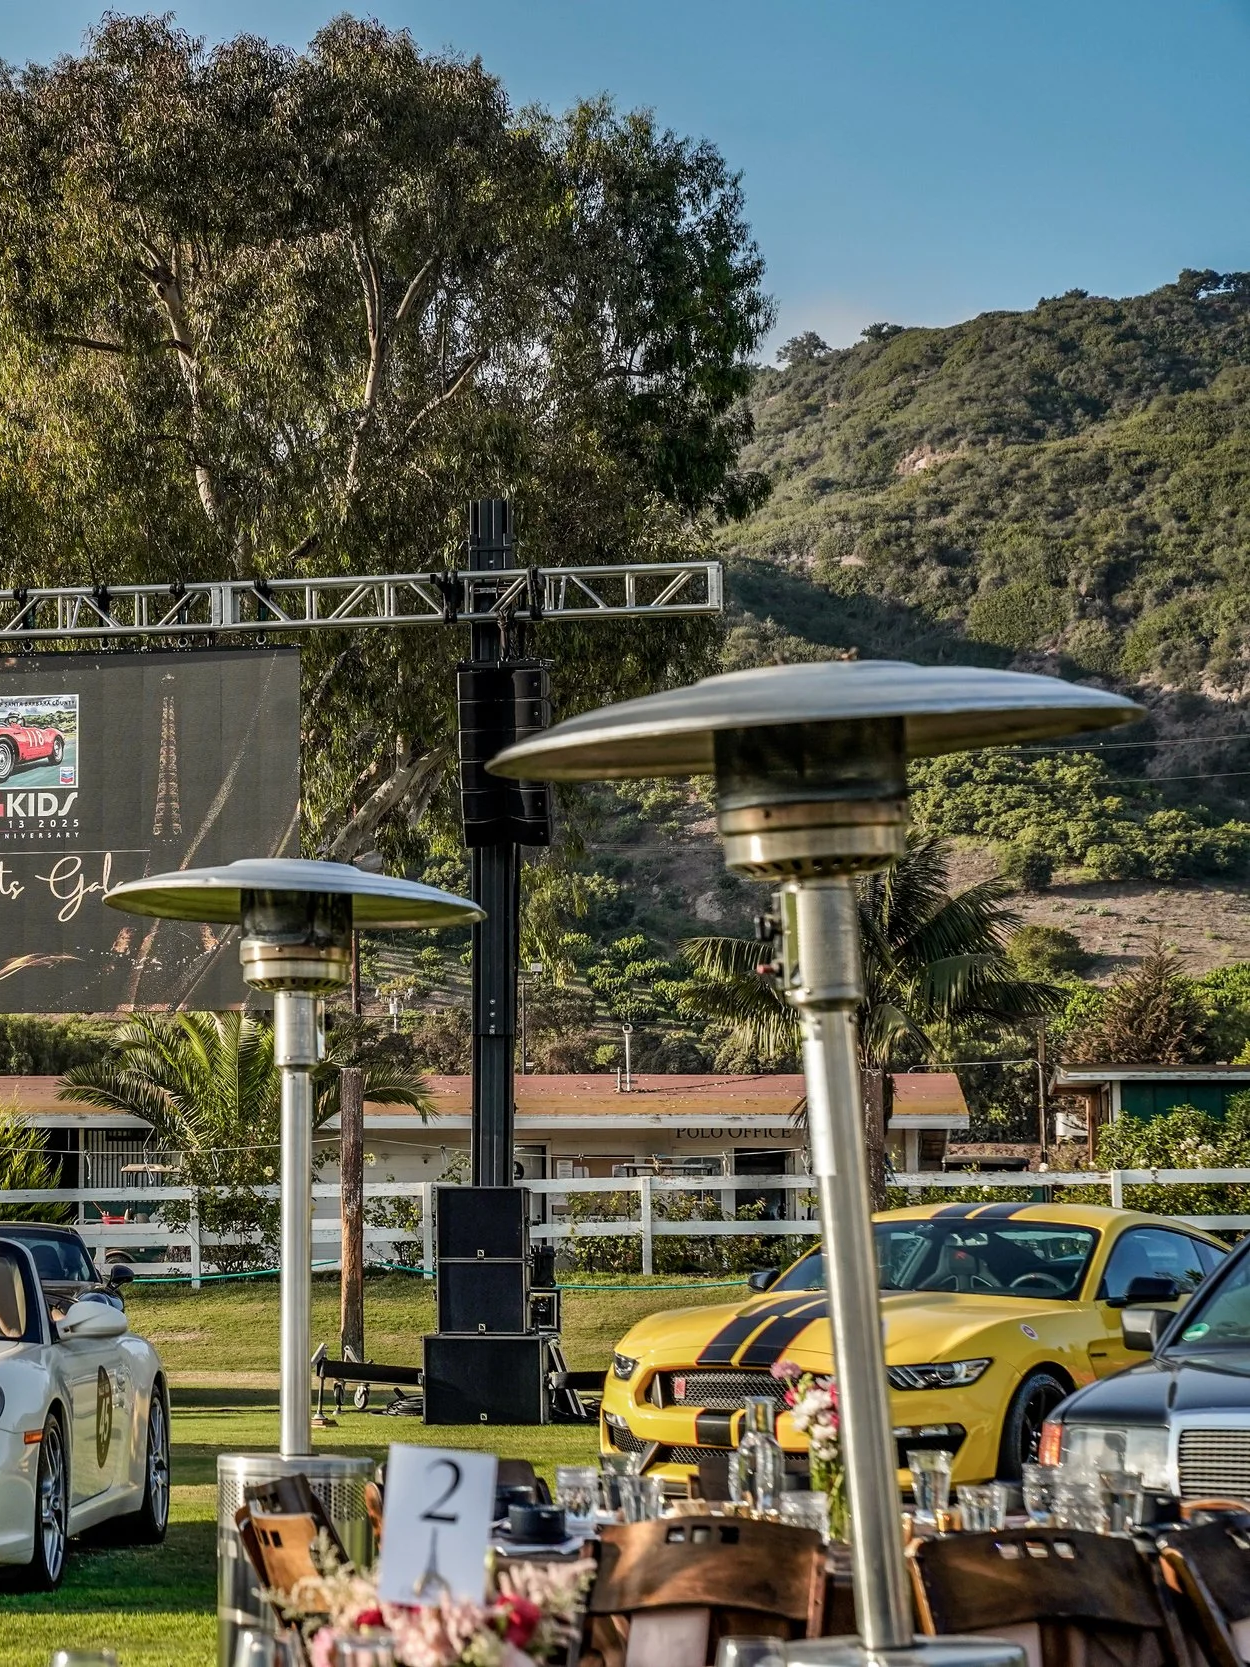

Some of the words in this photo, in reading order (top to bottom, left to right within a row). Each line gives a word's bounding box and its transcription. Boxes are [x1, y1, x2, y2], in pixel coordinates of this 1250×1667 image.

[25, 730, 45, 748] 118
[8, 820, 25, 829] 13
[38, 818, 79, 828] 2025
[675, 1127, 723, 1139] POLO
[728, 1127, 791, 1139] OFFICE
[420, 1458, 462, 1525] 2
